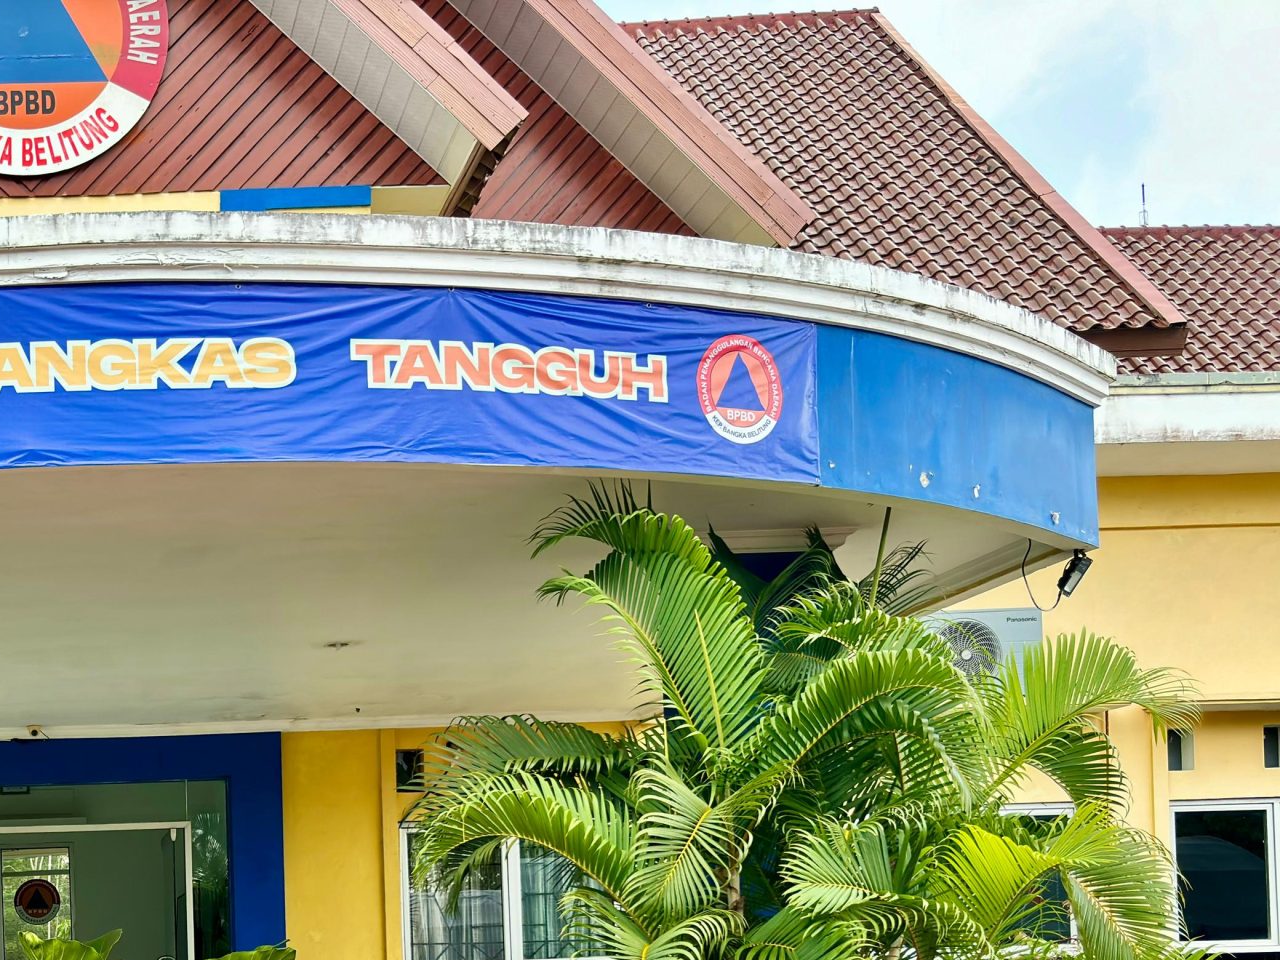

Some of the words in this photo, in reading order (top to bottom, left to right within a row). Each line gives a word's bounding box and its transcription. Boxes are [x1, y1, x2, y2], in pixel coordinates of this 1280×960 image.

[22, 107, 120, 167] BELITUNG
[349, 338, 669, 403] TANGGUH
[700, 338, 753, 381] PENANGGULANGAN
[753, 344, 777, 382] BENCANA
[701, 381, 713, 412] BADAN
[770, 383, 779, 418] DAERAH
[723, 426, 747, 438] BANGKA
[747, 418, 771, 438] BELITUNG
[726, 409, 756, 422] BPBD
